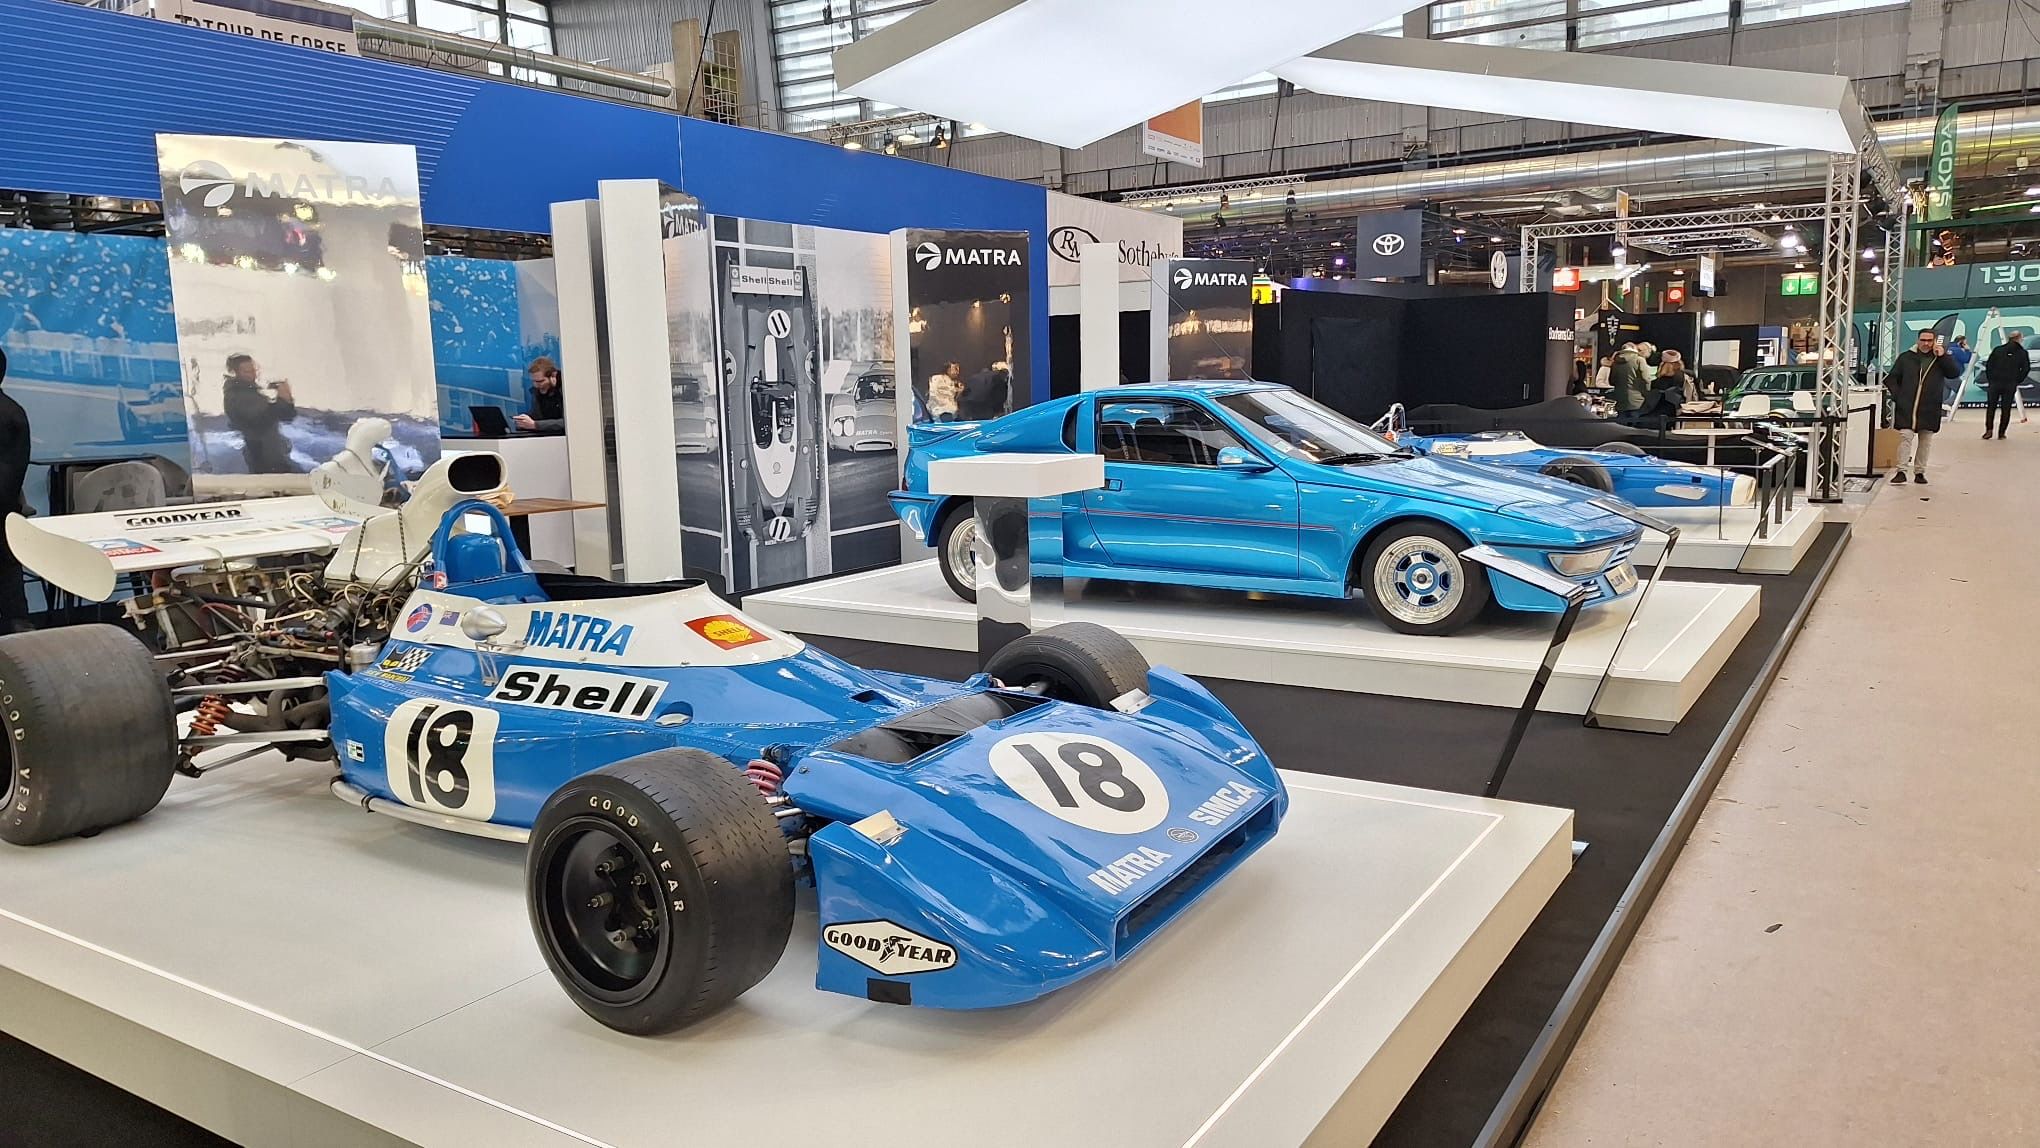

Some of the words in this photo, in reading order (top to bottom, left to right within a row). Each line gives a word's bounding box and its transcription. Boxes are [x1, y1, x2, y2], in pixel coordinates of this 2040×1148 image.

[244, 171, 400, 200] MATRA
[945, 248, 1022, 267] MATRA
[741, 275, 767, 285] Shell
[768, 277, 793, 286] Shell
[1194, 272, 1248, 287] MATRA
[1980, 264, 2040, 284] 130
[126, 509, 242, 527] GOODYEAR
[526, 610, 636, 657] MATRA
[713, 627, 744, 637] SHELL
[495, 671, 660, 717] Shell
[406, 703, 474, 809] 18
[1011, 742, 1146, 813] 18
[1086, 845, 1173, 896] MATRA
[1187, 778, 1261, 828] SIMCA
[589, 796, 639, 828] GOOD
[651, 840, 685, 913] YEAR
[826, 929, 881, 954] GOOD
[895, 941, 953, 966] YEAR
